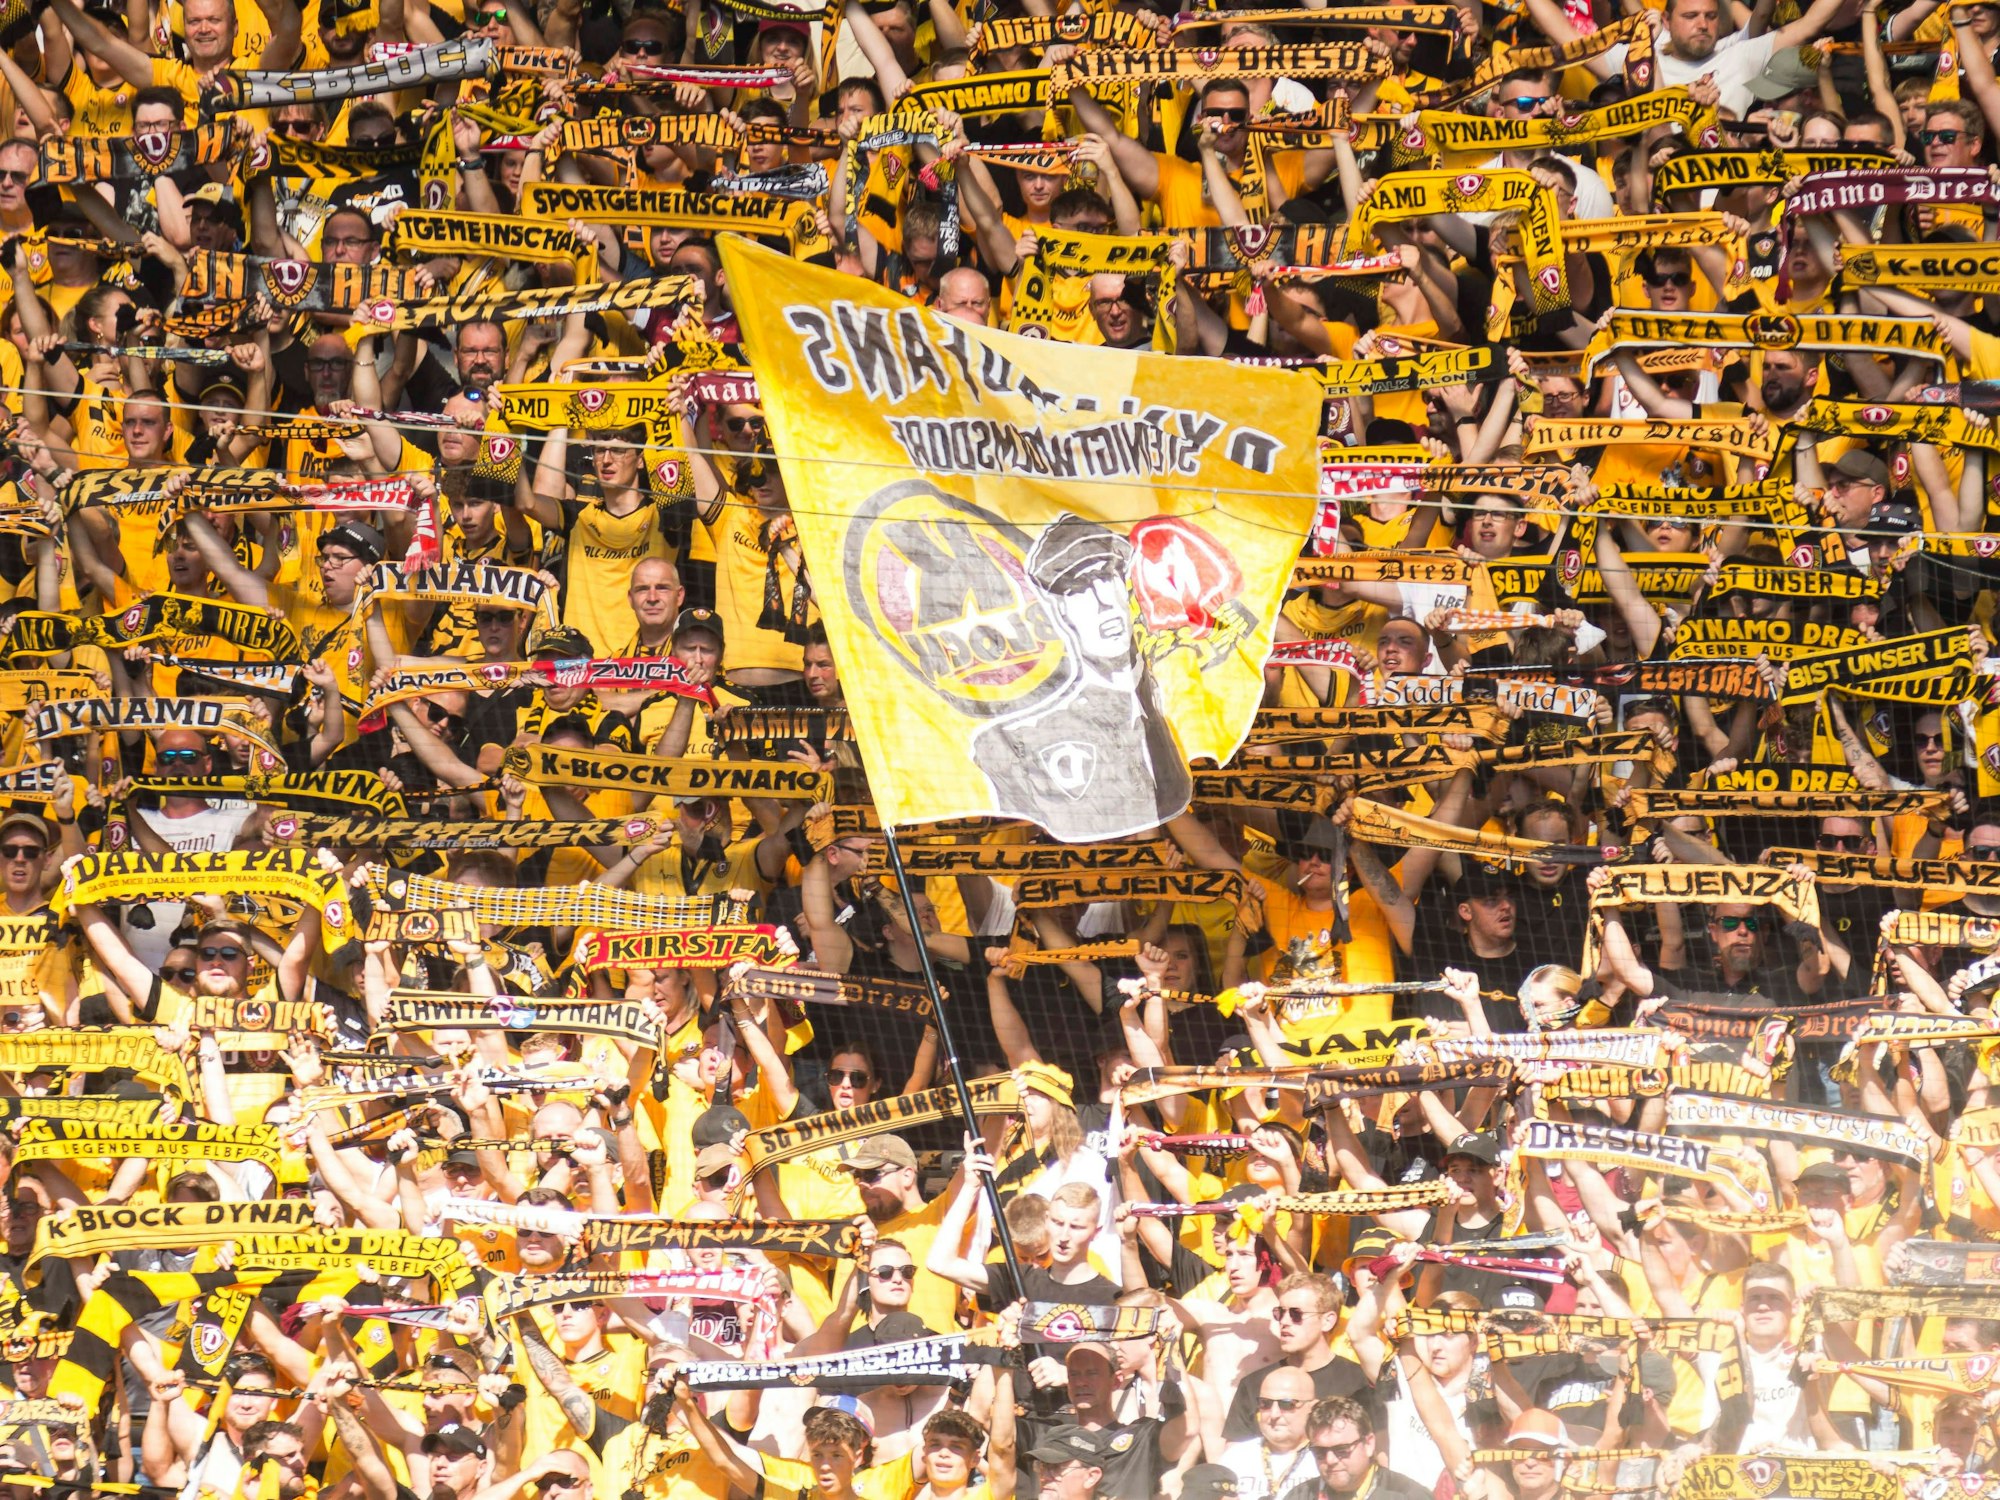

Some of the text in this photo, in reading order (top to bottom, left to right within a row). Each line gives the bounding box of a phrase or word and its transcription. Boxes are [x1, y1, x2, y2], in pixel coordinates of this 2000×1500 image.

[1432, 120, 1530, 145] DYNAMO
[533, 188, 791, 221] SPORTGEMEINSCHAFT
[1610, 319, 1723, 339] FORZA
[1359, 371, 1477, 393] WALK ALONE
[1685, 502, 1717, 515] AUS
[1754, 570, 1834, 593] UNSER
[1676, 620, 1791, 642] DYNAMO
[1761, 645, 1794, 658] AUS
[1789, 643, 1926, 689] BIST UNSER
[1384, 677, 1455, 706] Stadt
[36, 697, 223, 738] DYNAMO
[541, 752, 821, 792] K-BLOCK DYNAMO
[76, 850, 227, 884] DANKE
[63, 1120, 190, 1140] DYNAMO
[759, 1125, 792, 1154] SG
[793, 1100, 892, 1143] DYNAMO
[64, 1144, 140, 1155] LEGENDE
[157, 1144, 189, 1155] AUS
[1528, 1121, 1712, 1173] DRESDEN
[49, 1207, 187, 1239] K-BLOCK
[318, 1257, 352, 1268] AUS
